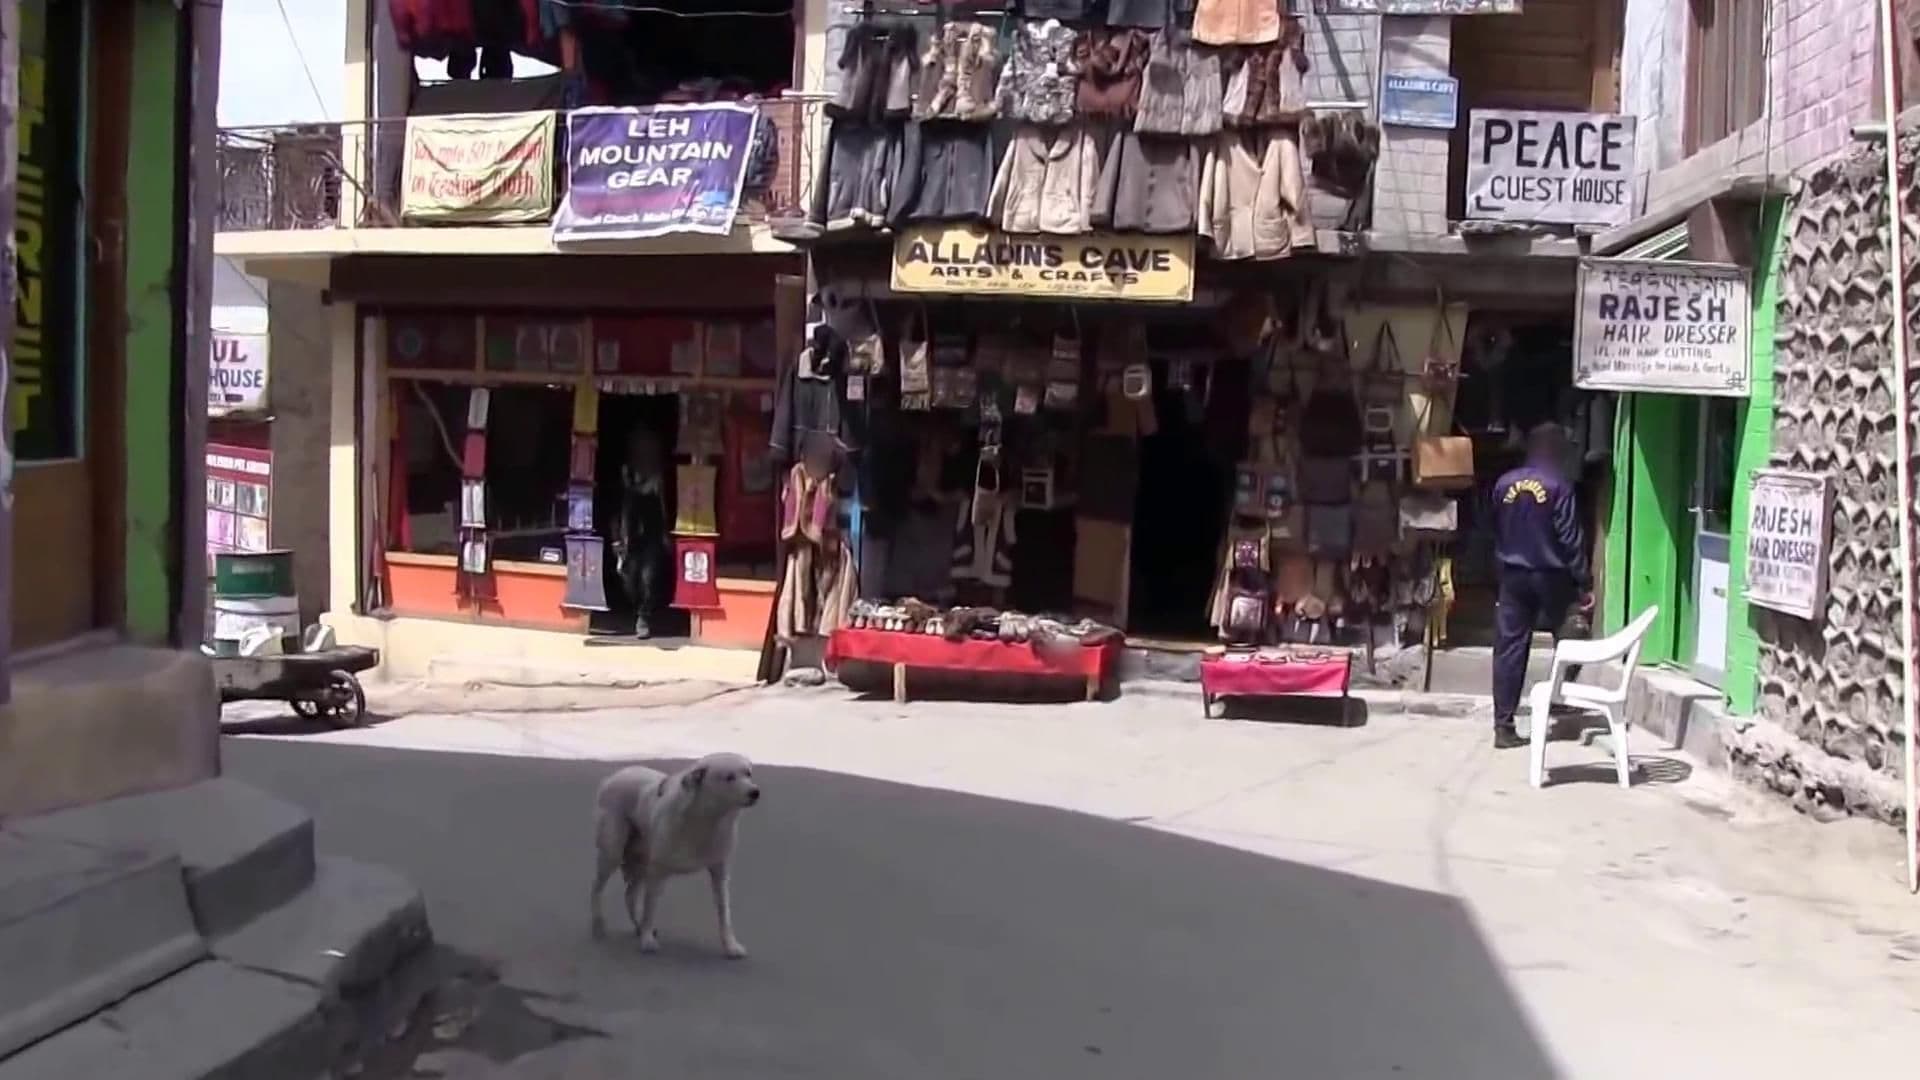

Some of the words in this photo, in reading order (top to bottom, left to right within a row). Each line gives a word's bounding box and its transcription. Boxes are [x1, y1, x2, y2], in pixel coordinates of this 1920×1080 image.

[628, 117, 690, 138] LEH
[579, 141, 733, 165] MOUNTAIN
[1484, 119, 1621, 171] PEACE
[607, 167, 692, 189] GEAR
[1572, 178, 1626, 204] HOUSE
[905, 242, 1063, 267] ALLADINS
[1079, 247, 1171, 273] CAVE
[930, 266, 993, 279] ARTS
[1011, 269, 1024, 281] &
[1039, 269, 1140, 285] CRAFTS
[1600, 293, 1727, 323] RAJESH
[1603, 323, 1651, 344] HAIR
[1664, 324, 1737, 345] DRESSER
[1664, 346, 1713, 360] CUTTING
[1752, 505, 1812, 537] RAJESH
[1772, 538, 1815, 565] DRESSER
